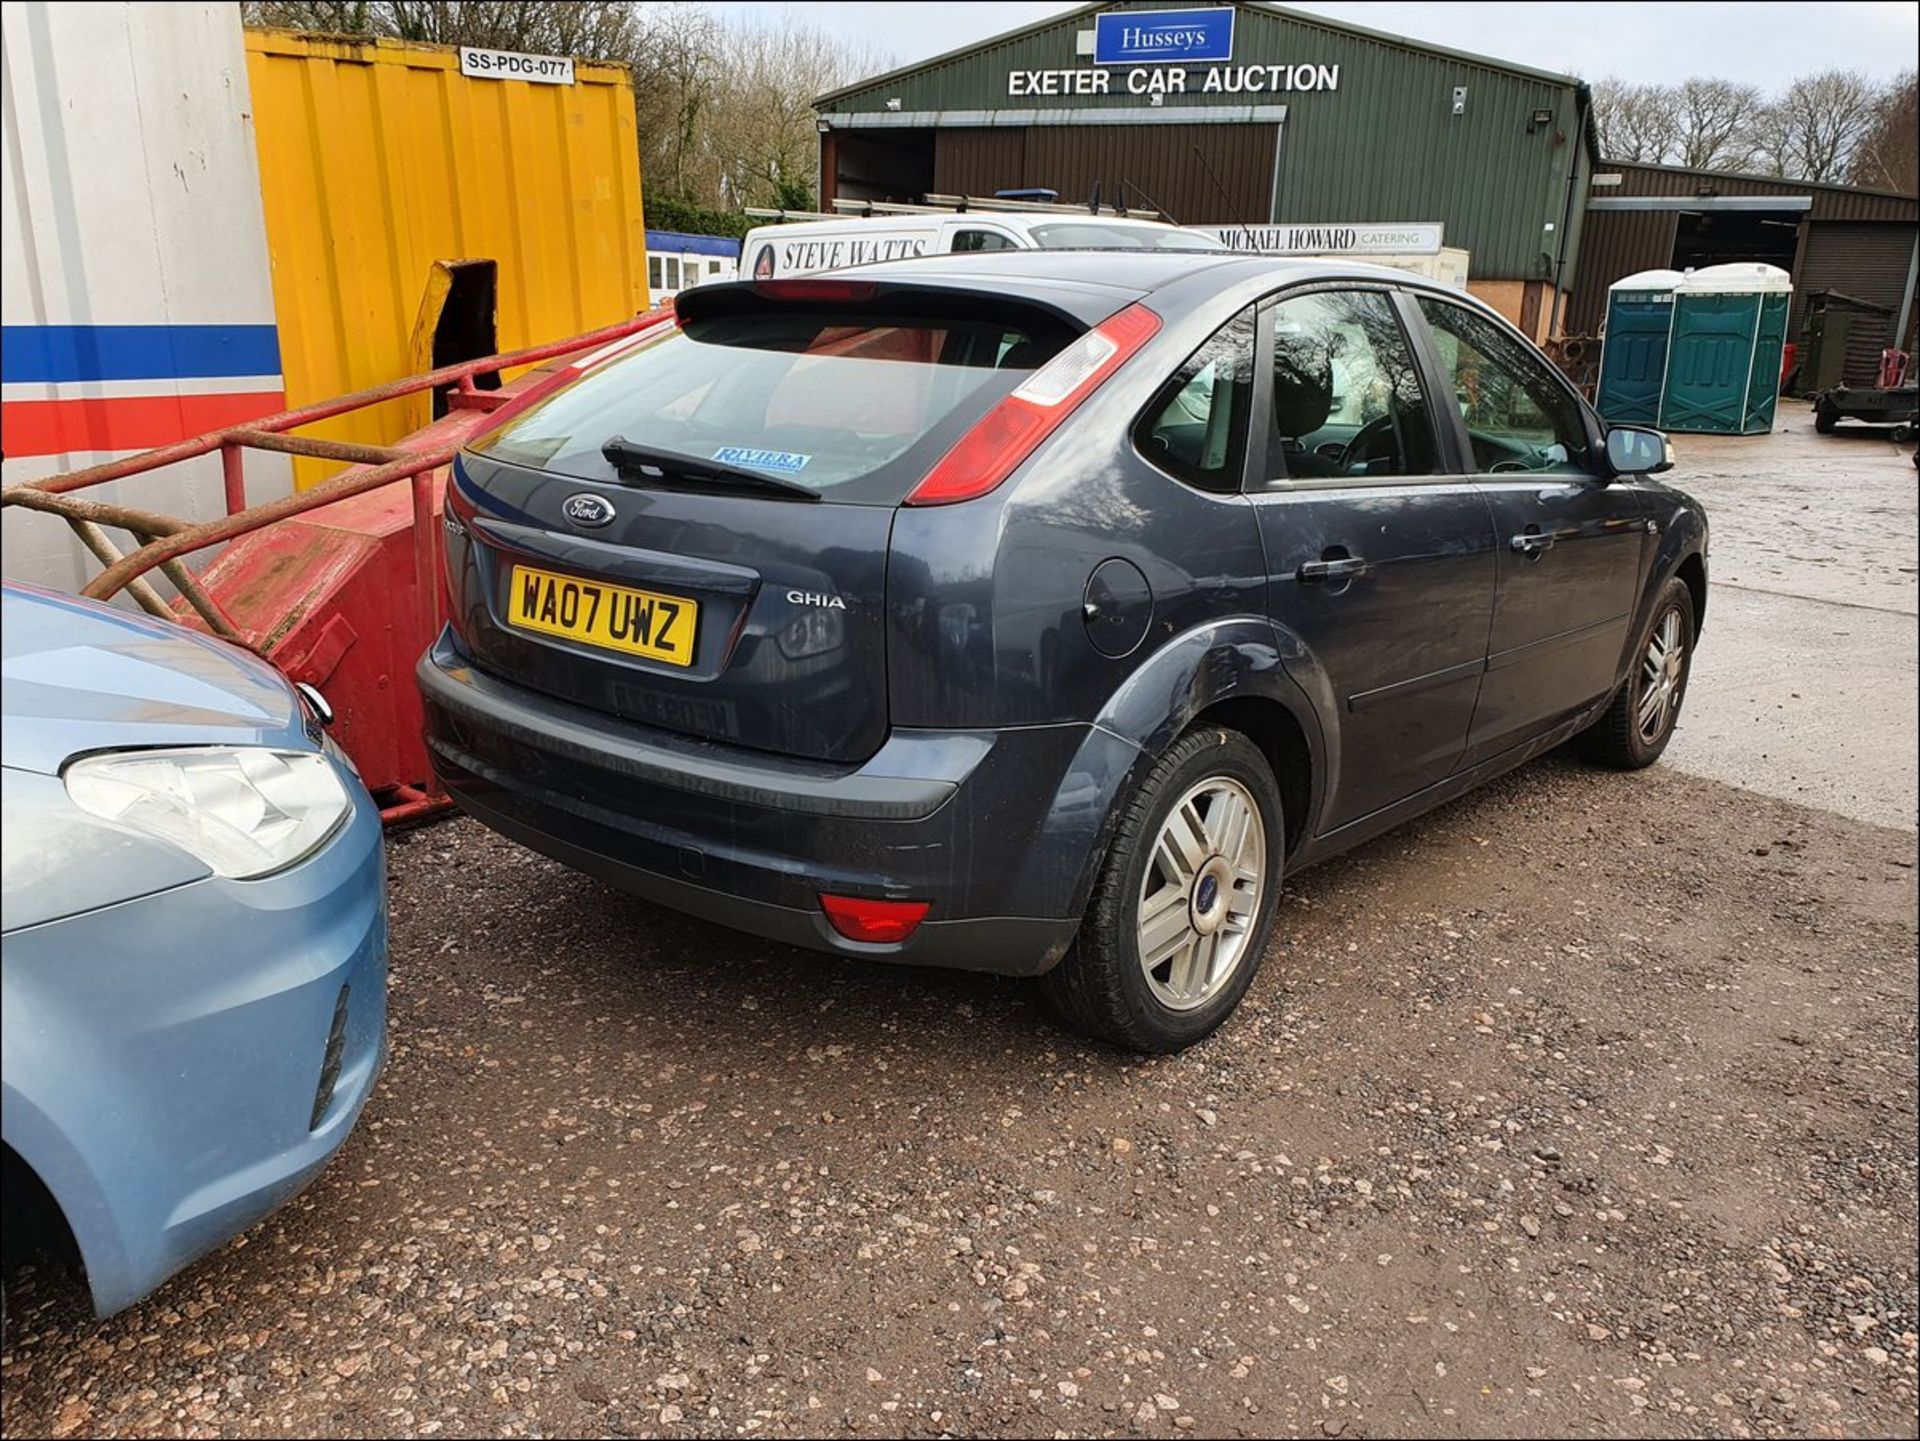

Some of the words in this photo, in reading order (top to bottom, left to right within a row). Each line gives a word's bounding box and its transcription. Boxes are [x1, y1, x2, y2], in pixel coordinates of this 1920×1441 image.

[1122, 27, 1206, 51] Husseys
[467, 52, 567, 77] SS-PDG-077
[1008, 69, 1111, 95] EXETER
[1127, 67, 1187, 94] CAR
[1202, 64, 1340, 93] AUCTION
[1219, 229, 1285, 250] MICHAEL
[1287, 229, 1356, 250] HOWARD
[1361, 232, 1420, 245] CATERING
[783, 241, 845, 270] STEVE
[850, 238, 926, 265] WATTS
[714, 447, 805, 466] RIVIERA
[569, 499, 600, 520] Ford
[786, 590, 847, 610] GHIA
[521, 573, 602, 634] WA07
[609, 591, 681, 653] UWZ
